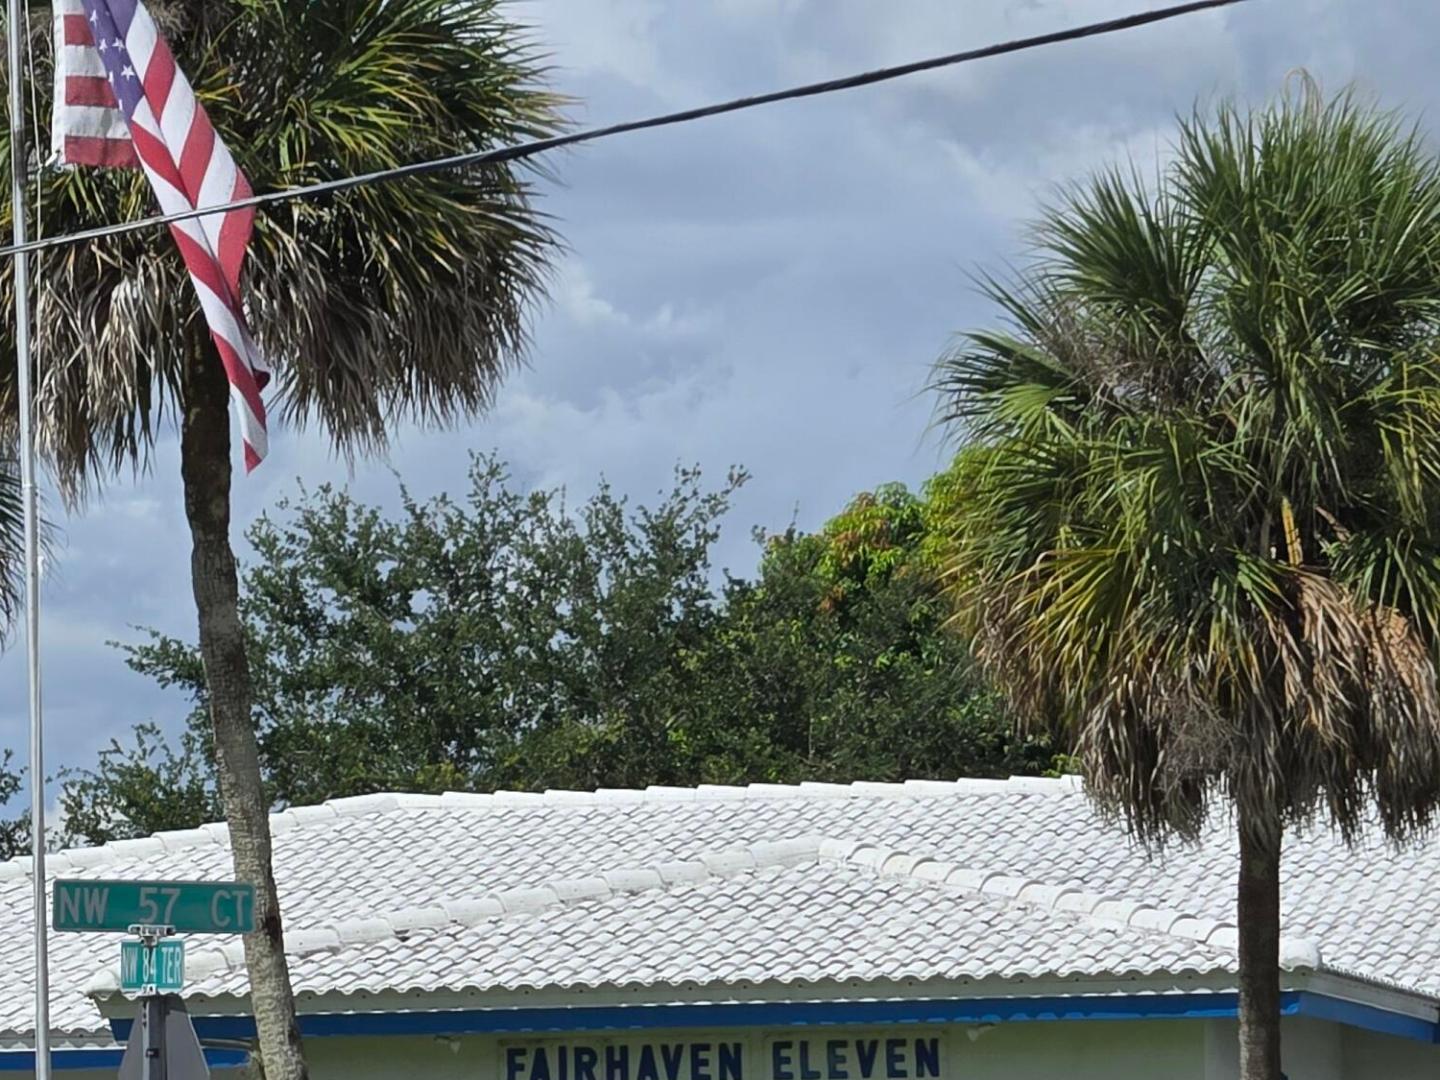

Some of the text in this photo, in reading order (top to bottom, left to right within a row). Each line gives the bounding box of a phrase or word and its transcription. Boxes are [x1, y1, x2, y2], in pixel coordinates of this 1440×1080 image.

[60, 886, 249, 928] NW 57 CT
[122, 947, 138, 983] NW
[161, 947, 180, 984] TER
[772, 1038, 940, 1080] ELEVEN
